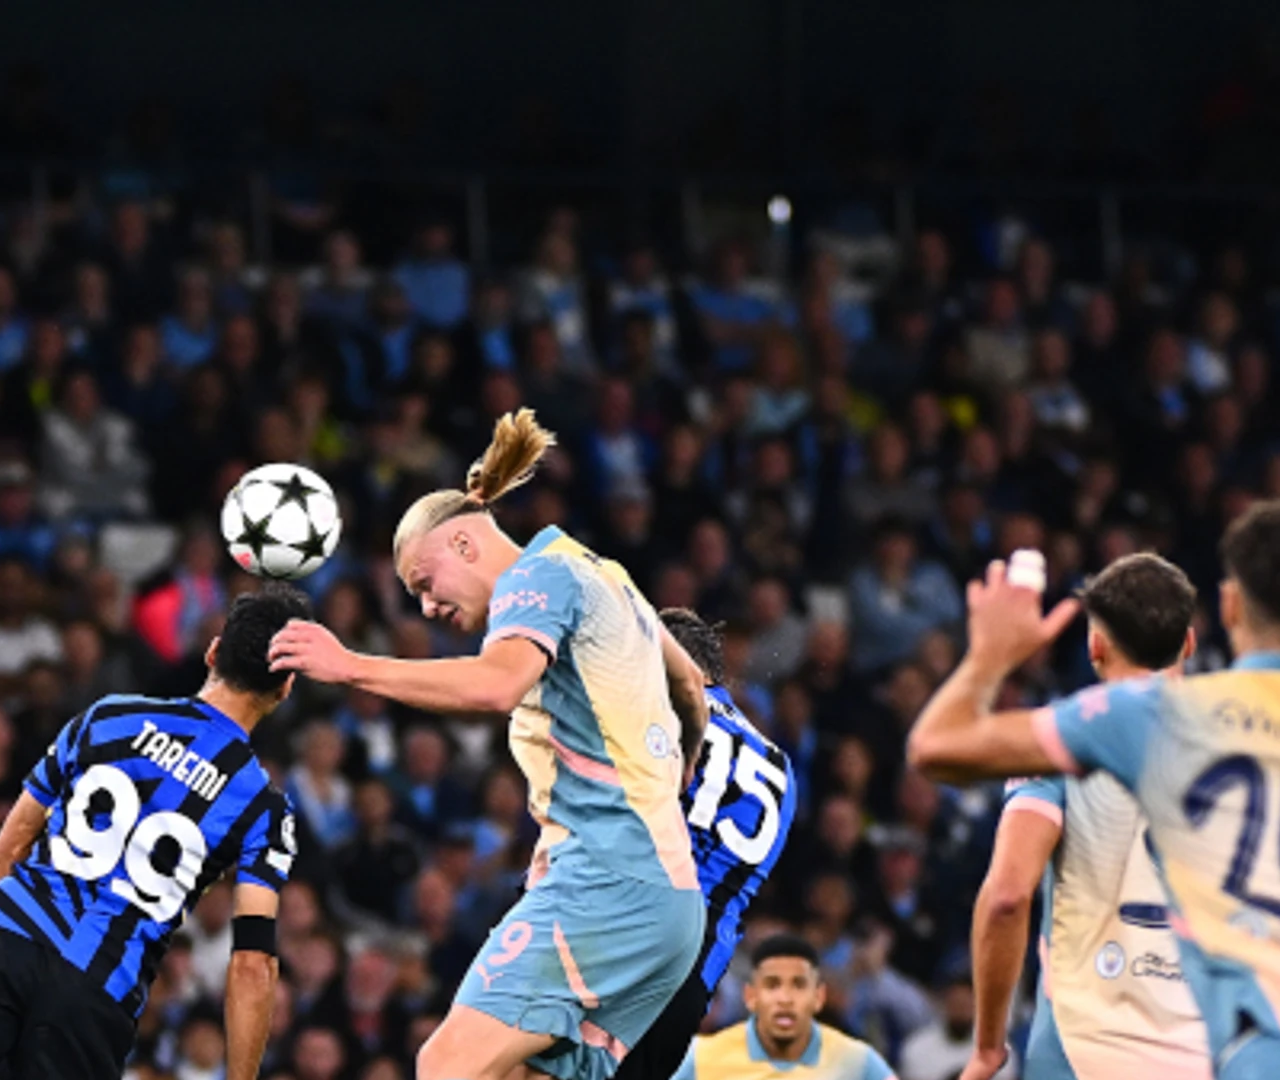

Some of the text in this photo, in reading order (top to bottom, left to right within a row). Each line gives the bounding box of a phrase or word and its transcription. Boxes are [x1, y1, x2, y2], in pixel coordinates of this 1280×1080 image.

[131, 720, 228, 801] TAREMI
[687, 719, 788, 865] 15
[50, 764, 207, 923] 99
[488, 921, 533, 966] 9
